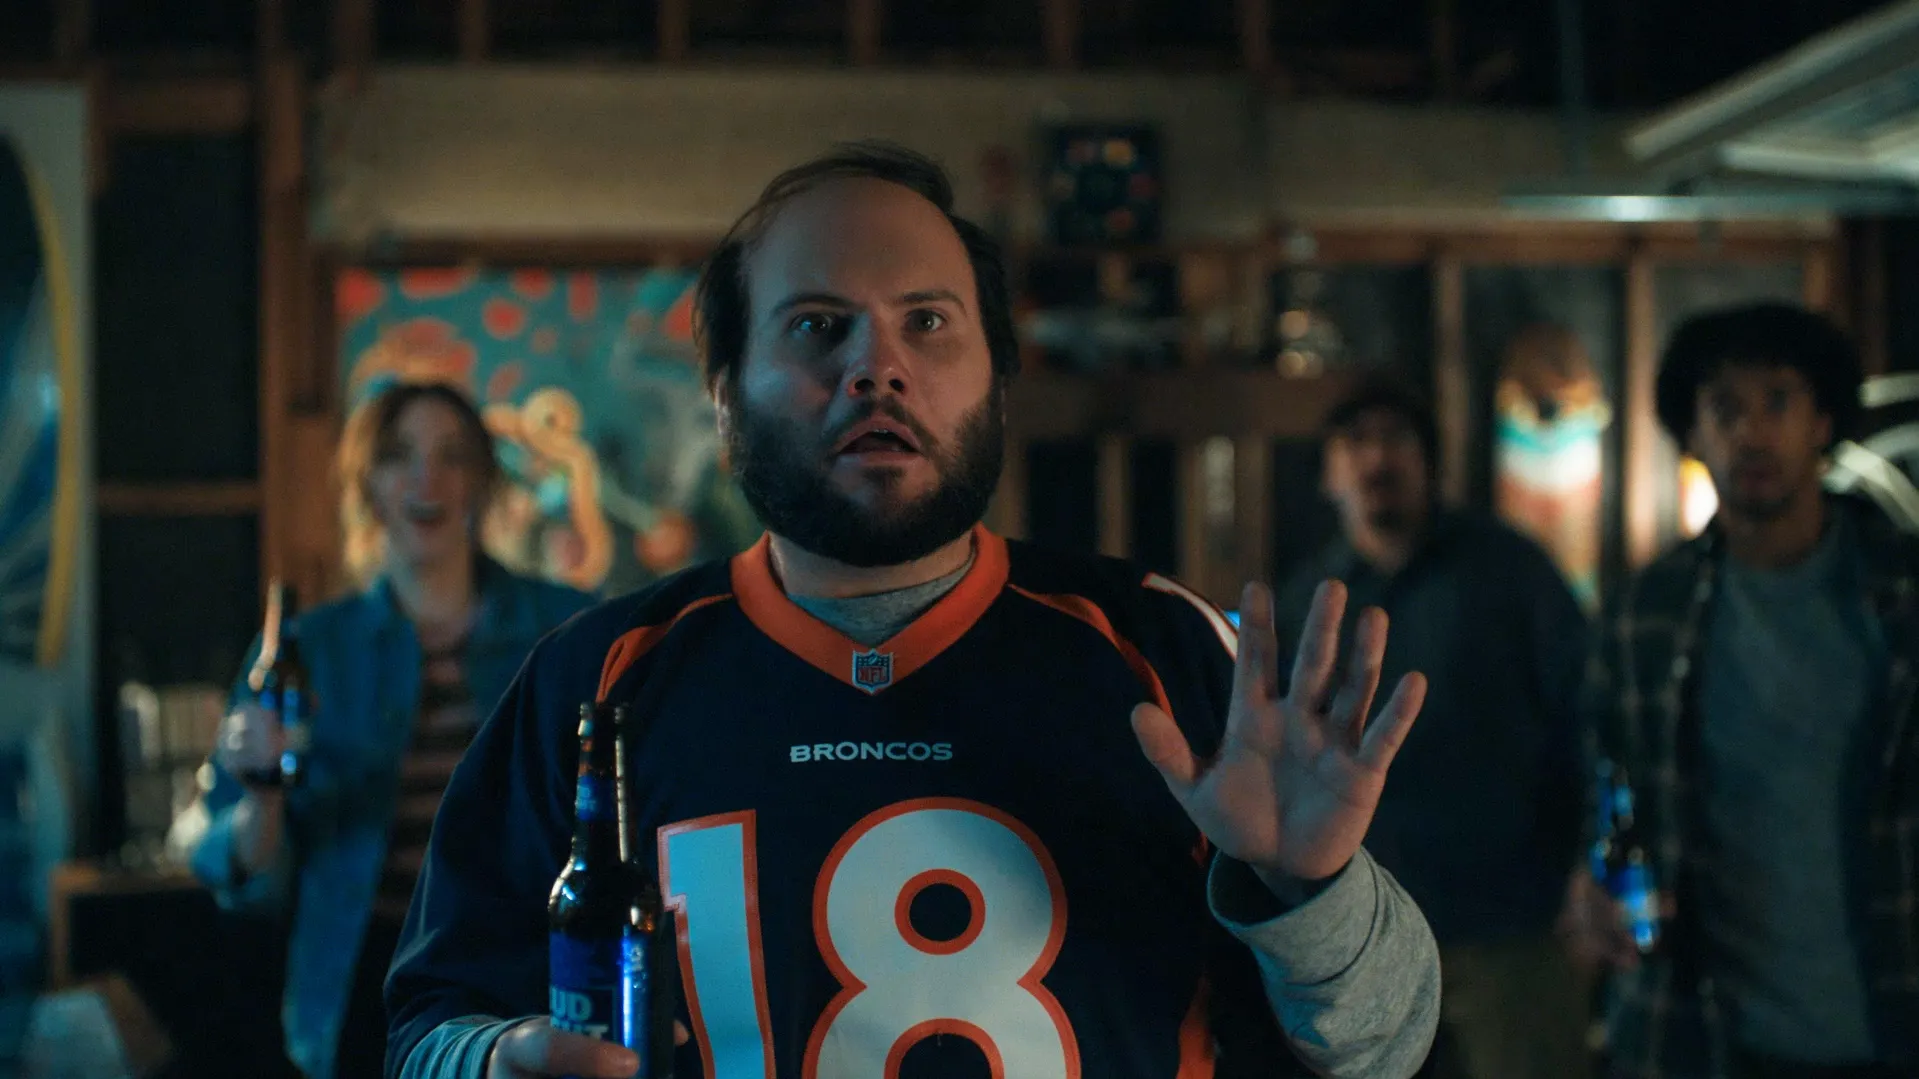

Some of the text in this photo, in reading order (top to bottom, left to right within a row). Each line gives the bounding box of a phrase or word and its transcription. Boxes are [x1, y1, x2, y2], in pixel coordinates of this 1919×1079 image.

[858, 666, 888, 683] NFL
[789, 741, 954, 763] BRONCOS
[656, 796, 1082, 1079] 18
[549, 985, 594, 1021] UD
